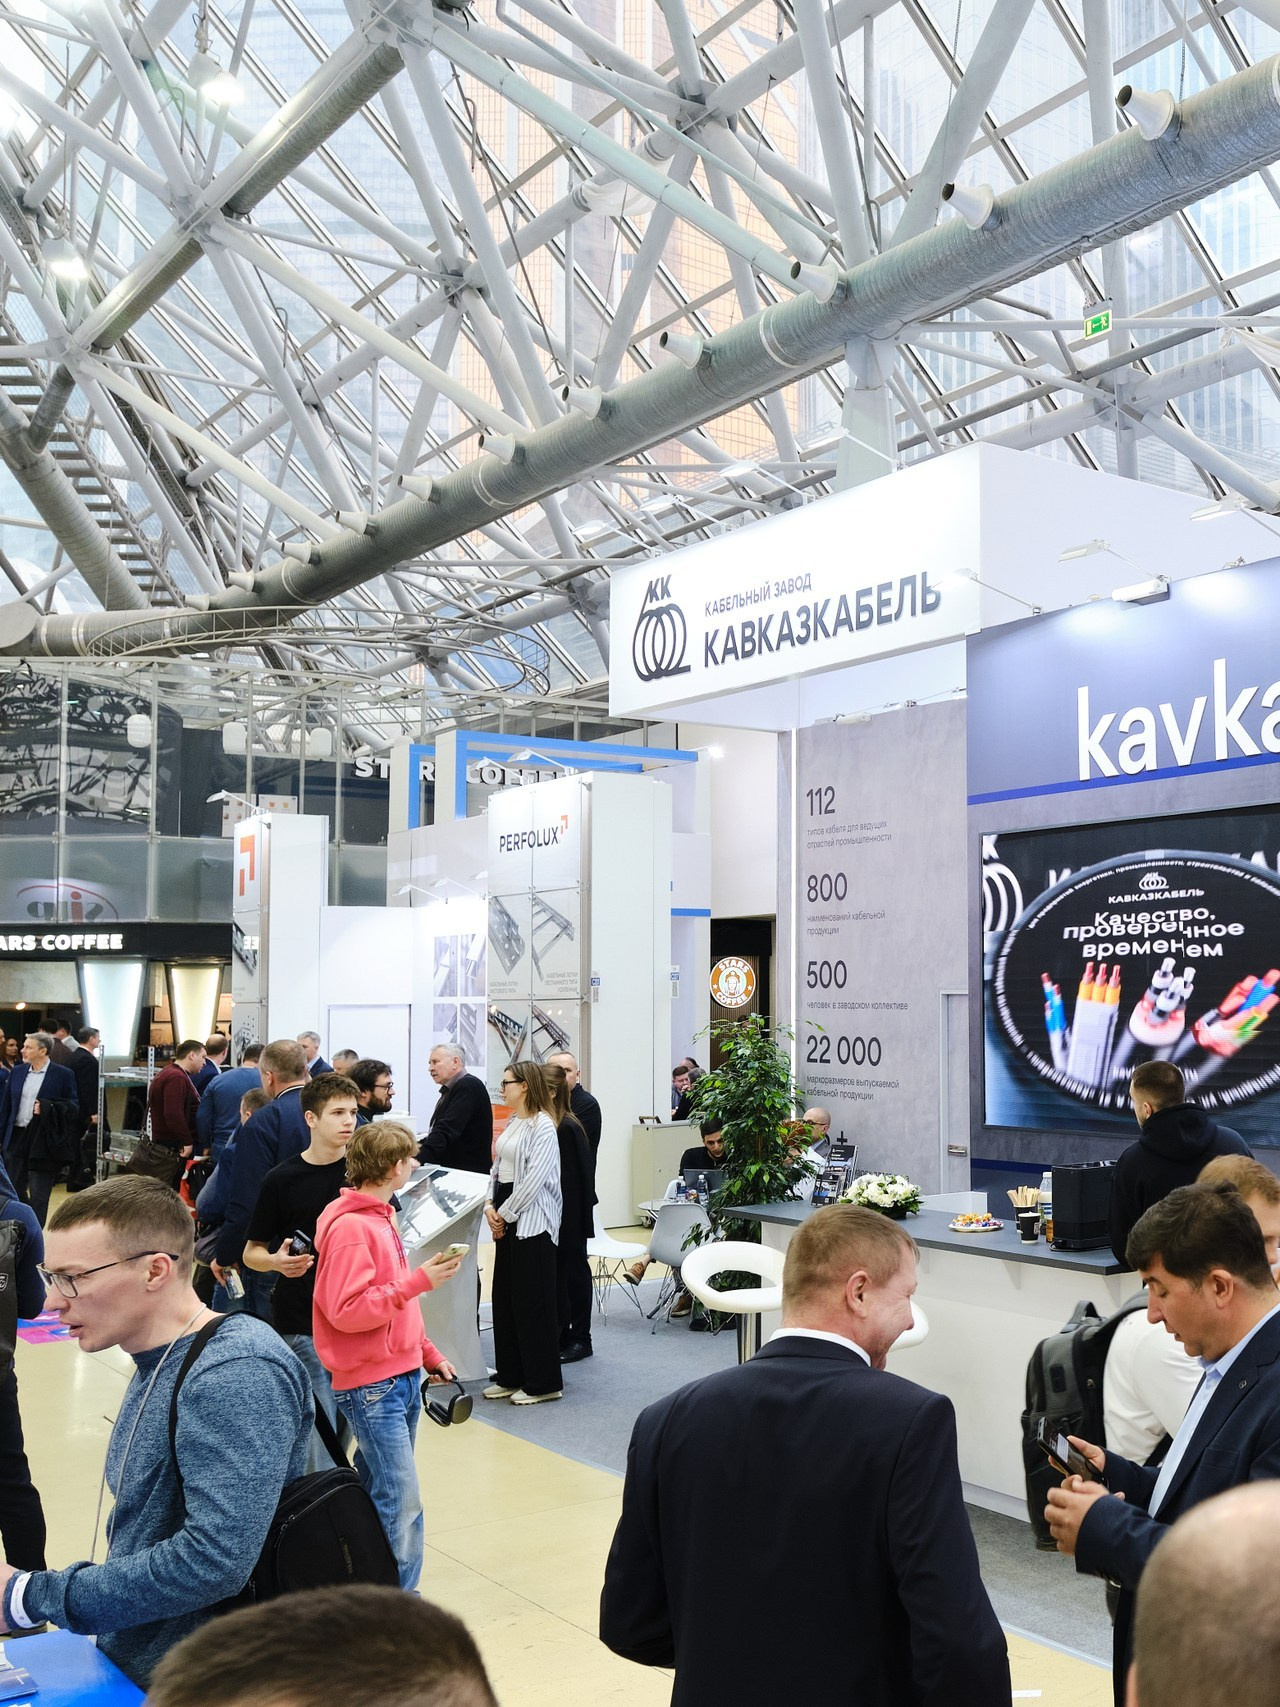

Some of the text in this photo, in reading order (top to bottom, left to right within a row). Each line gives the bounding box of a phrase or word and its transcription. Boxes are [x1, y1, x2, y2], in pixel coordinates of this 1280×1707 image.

[704, 572, 812, 617] КАБЕЛЬНЫЙ ЗАВОД
[704, 571, 942, 668] КАВКАЗКАБЕЛЬ
[806, 785, 836, 816] 112
[807, 827, 825, 836] типов
[847, 823, 859, 833] для
[499, 826, 560, 853] PERFOLUX
[836, 833, 892, 847] промышленности
[807, 872, 848, 903] 800
[1108, 887, 1205, 904] КАВКАЗКАБЕЛЬ
[1094, 907, 1216, 927] Качество,
[41, 934, 124, 950] COFFEE
[718, 960, 749, 973] STARS
[806, 960, 848, 989] 500
[716, 992, 748, 1006] COFFEE
[807, 1001, 831, 1009] человек
[871, 1002, 909, 1010] коллективе
[806, 1034, 882, 1067] 22 000
[806, 1075, 900, 1089] маркоразмеров выпускаемой
[806, 1086, 874, 1101] кабельной продукции
